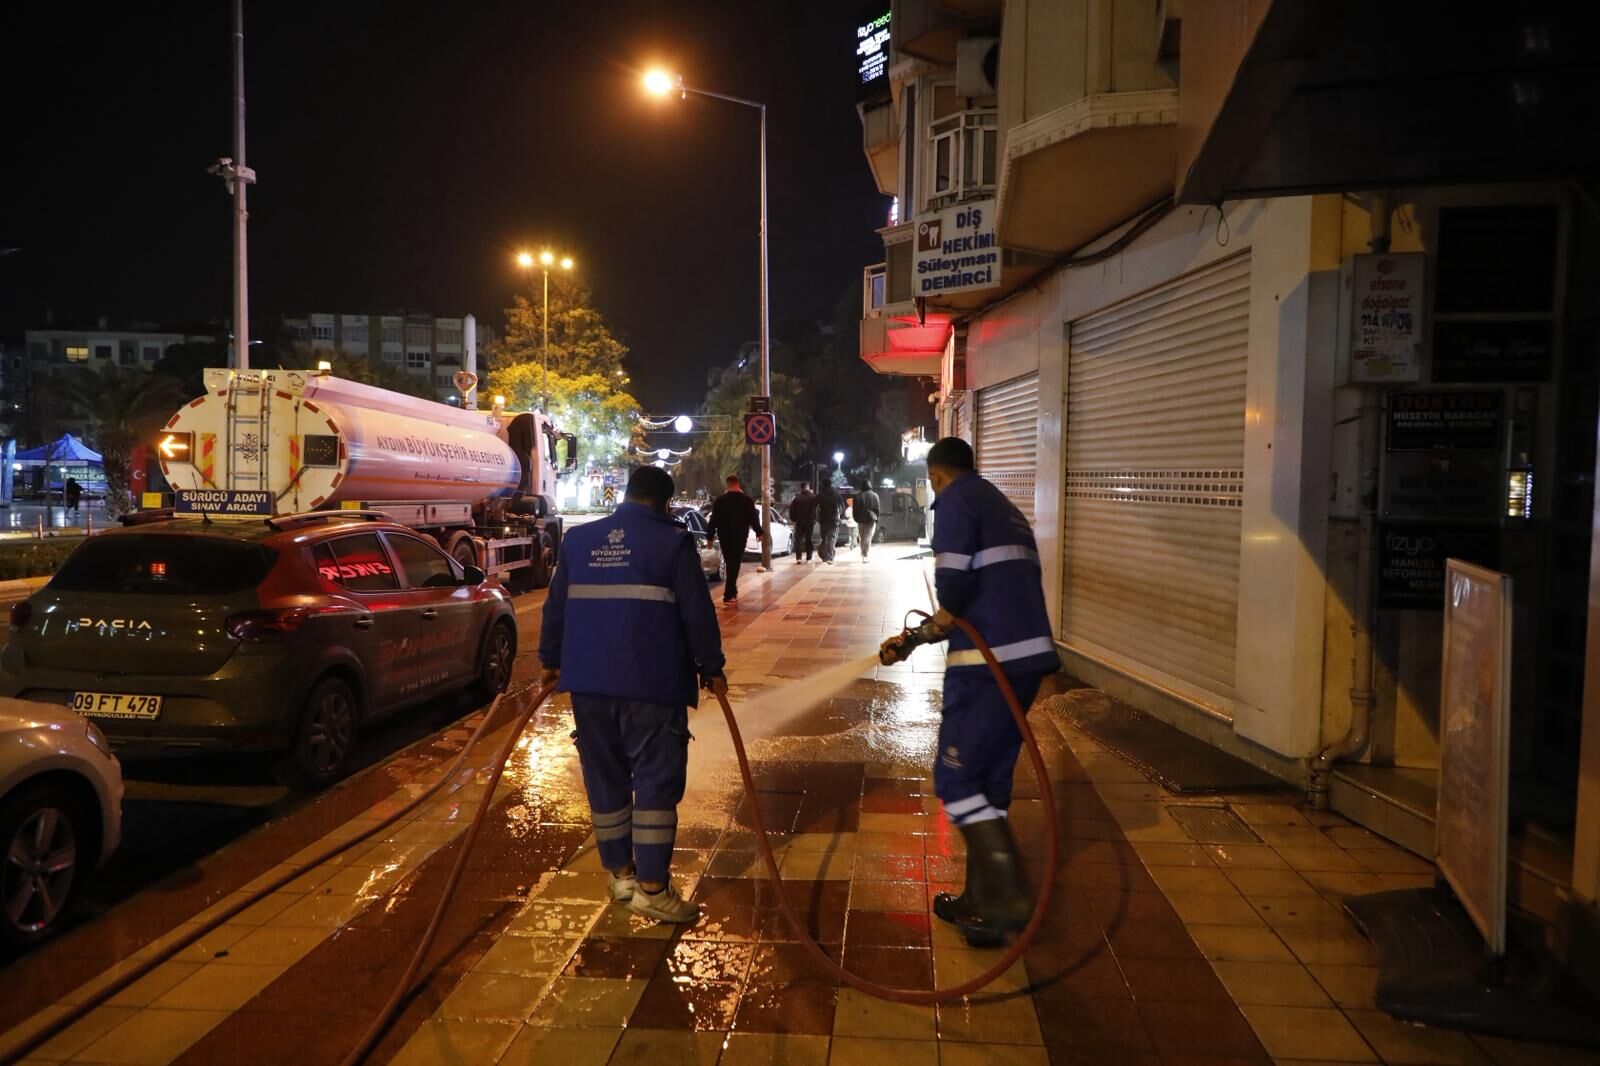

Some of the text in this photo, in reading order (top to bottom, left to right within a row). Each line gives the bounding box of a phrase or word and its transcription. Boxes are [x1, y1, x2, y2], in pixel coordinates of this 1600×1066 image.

[956, 206, 982, 229] DİŞ
[943, 228, 995, 255] HEKİMİ
[917, 253, 997, 274] Süleyman
[921, 265, 992, 291] DEMİRCİ
[376, 435, 506, 466] AYDIN BÜYÜKŞEHİR BELEDİYESİ
[182, 491, 267, 503] SÜRÜCÜ ADAYI
[191, 503, 257, 512] SINAV ARACI
[80, 618, 152, 629] DACIA
[74, 693, 157, 713] 09 FT 478
